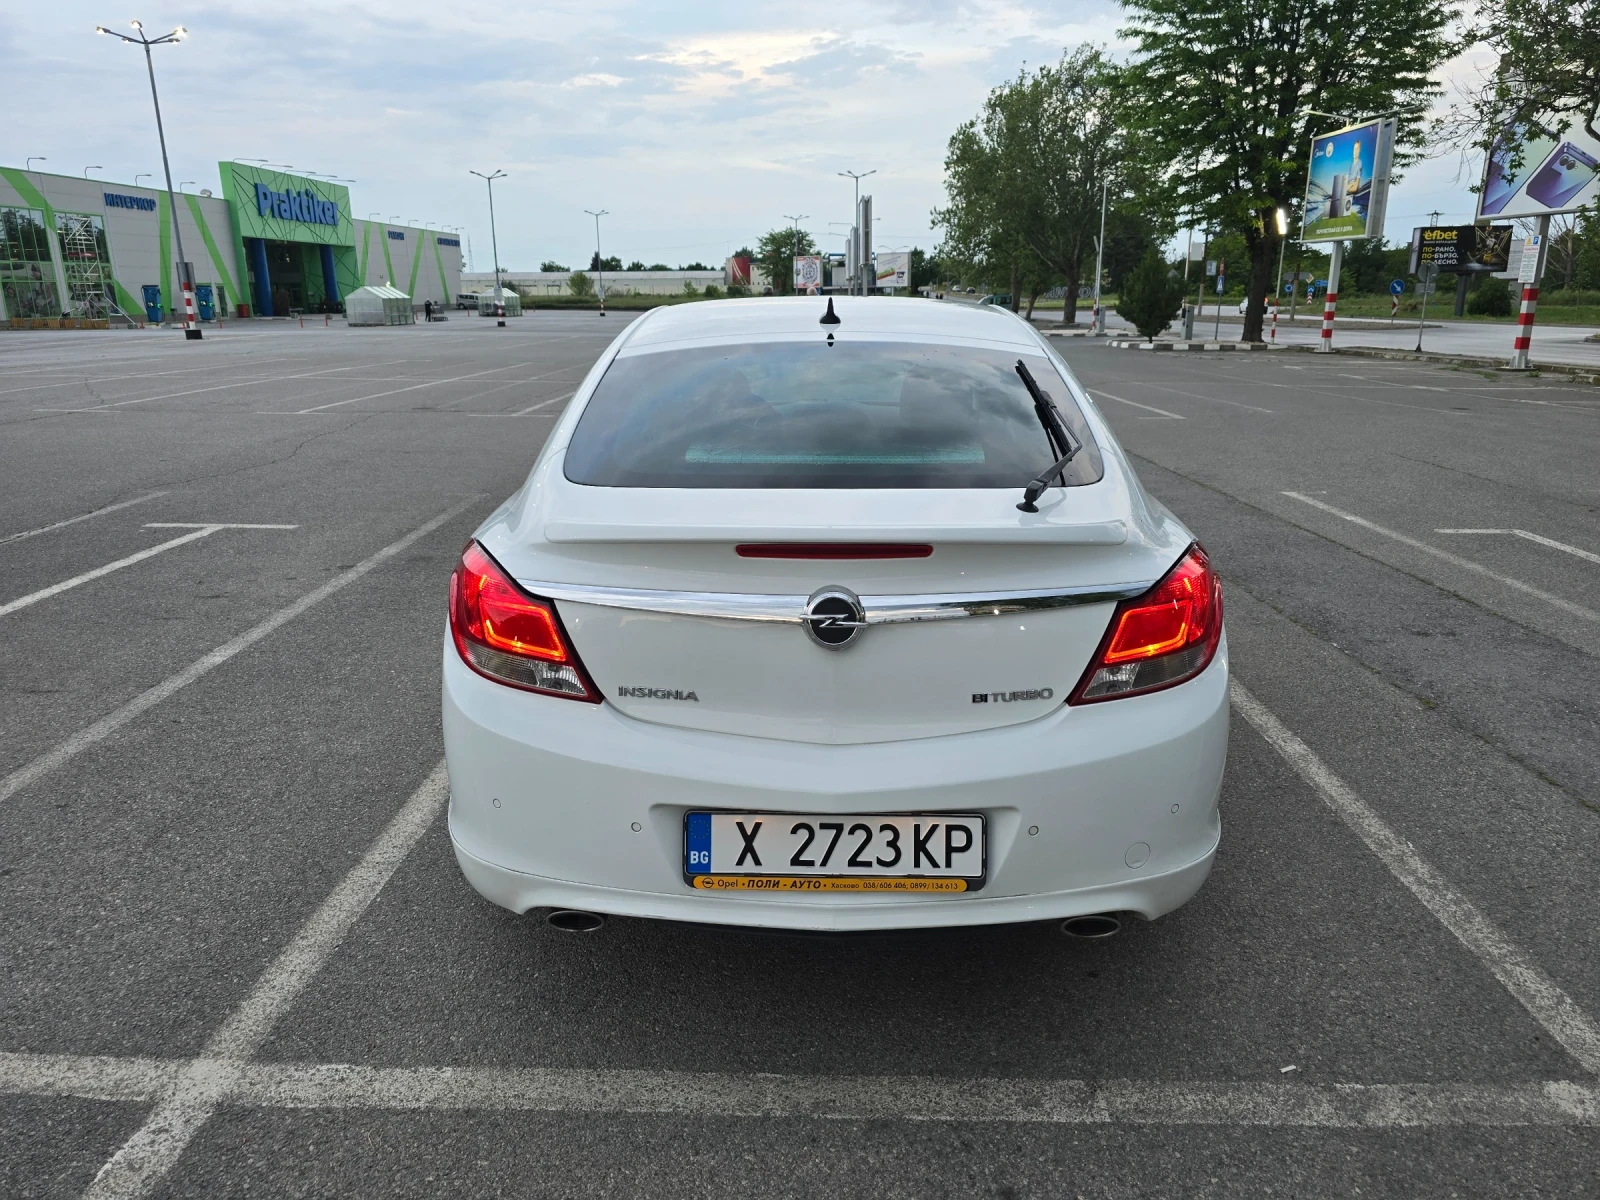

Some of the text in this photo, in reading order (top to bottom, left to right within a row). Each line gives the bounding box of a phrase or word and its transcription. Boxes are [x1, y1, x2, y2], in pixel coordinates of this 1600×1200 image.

[104, 192, 157, 212] ИНТЕРИОР
[254, 182, 339, 227] Praktiker
[1423, 229, 1458, 240] efbet
[618, 686, 700, 702] INSIGNIA
[972, 687, 1054, 704] BI TURBO
[735, 821, 973, 869] X 2723 KP
[689, 850, 710, 865] BG
[717, 879, 738, 889] Opel
[747, 880, 780, 889] ПОЛИ
[790, 880, 822, 889] АУТО
[893, 882, 909, 890] 406;
[910, 882, 943, 890] 0899/134
[945, 882, 958, 890] 613
